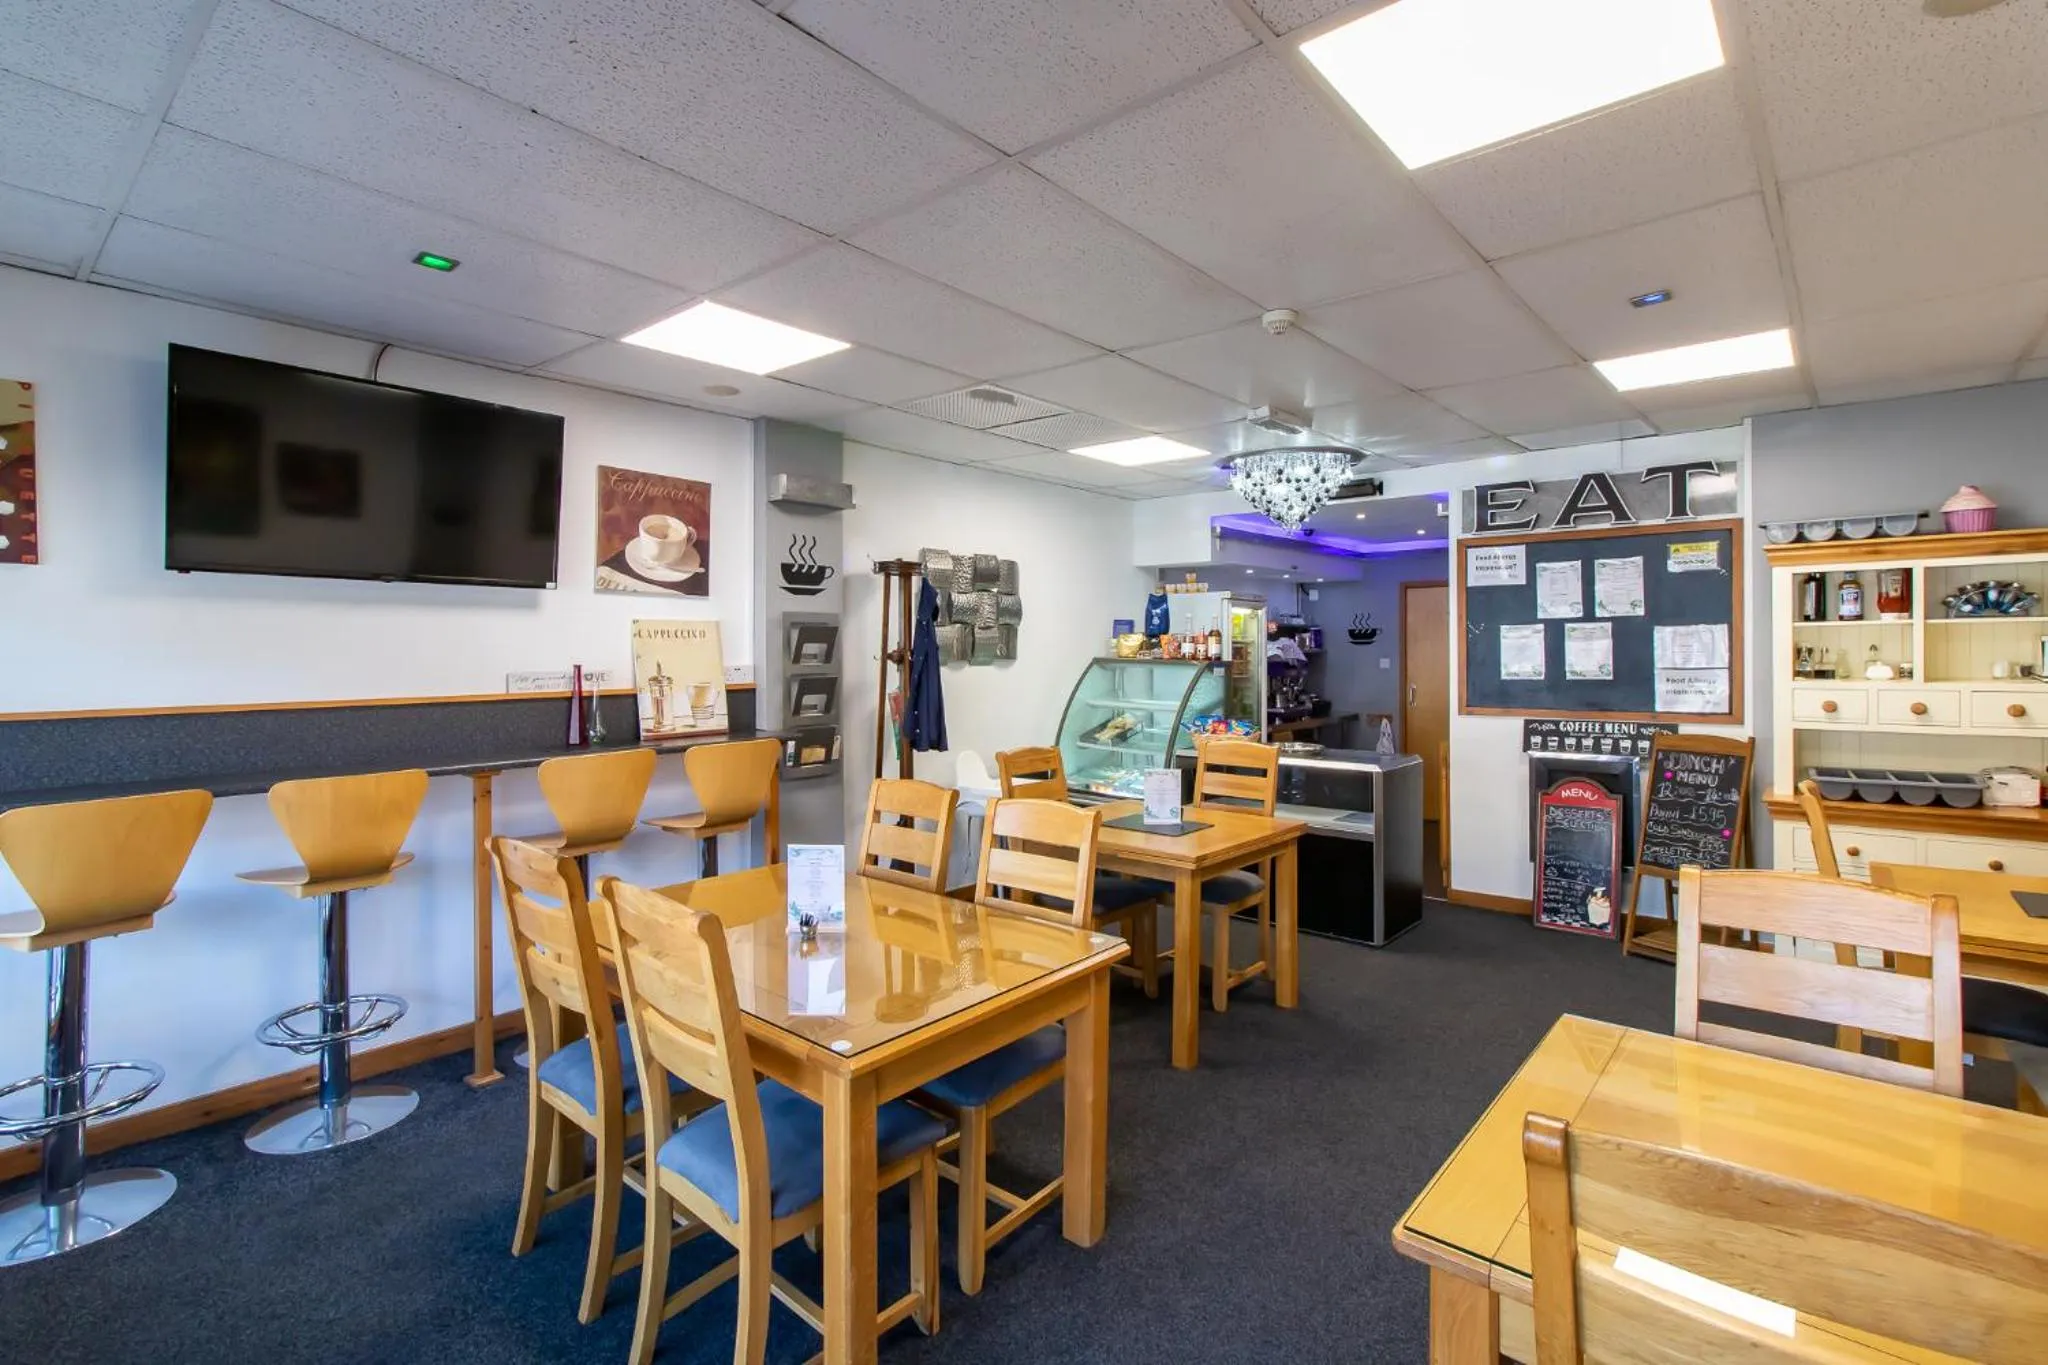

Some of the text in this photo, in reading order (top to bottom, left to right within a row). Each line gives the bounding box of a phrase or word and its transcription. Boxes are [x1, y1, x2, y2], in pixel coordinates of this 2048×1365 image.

[608, 470, 702, 501] Cappuccino
[1473, 459, 1720, 535] EAT
[1559, 721, 1601, 733] COFFEE
[1604, 722, 1638, 735] MENU
[1676, 771, 1719, 787] MENU
[1561, 788, 1598, 801] MENU
